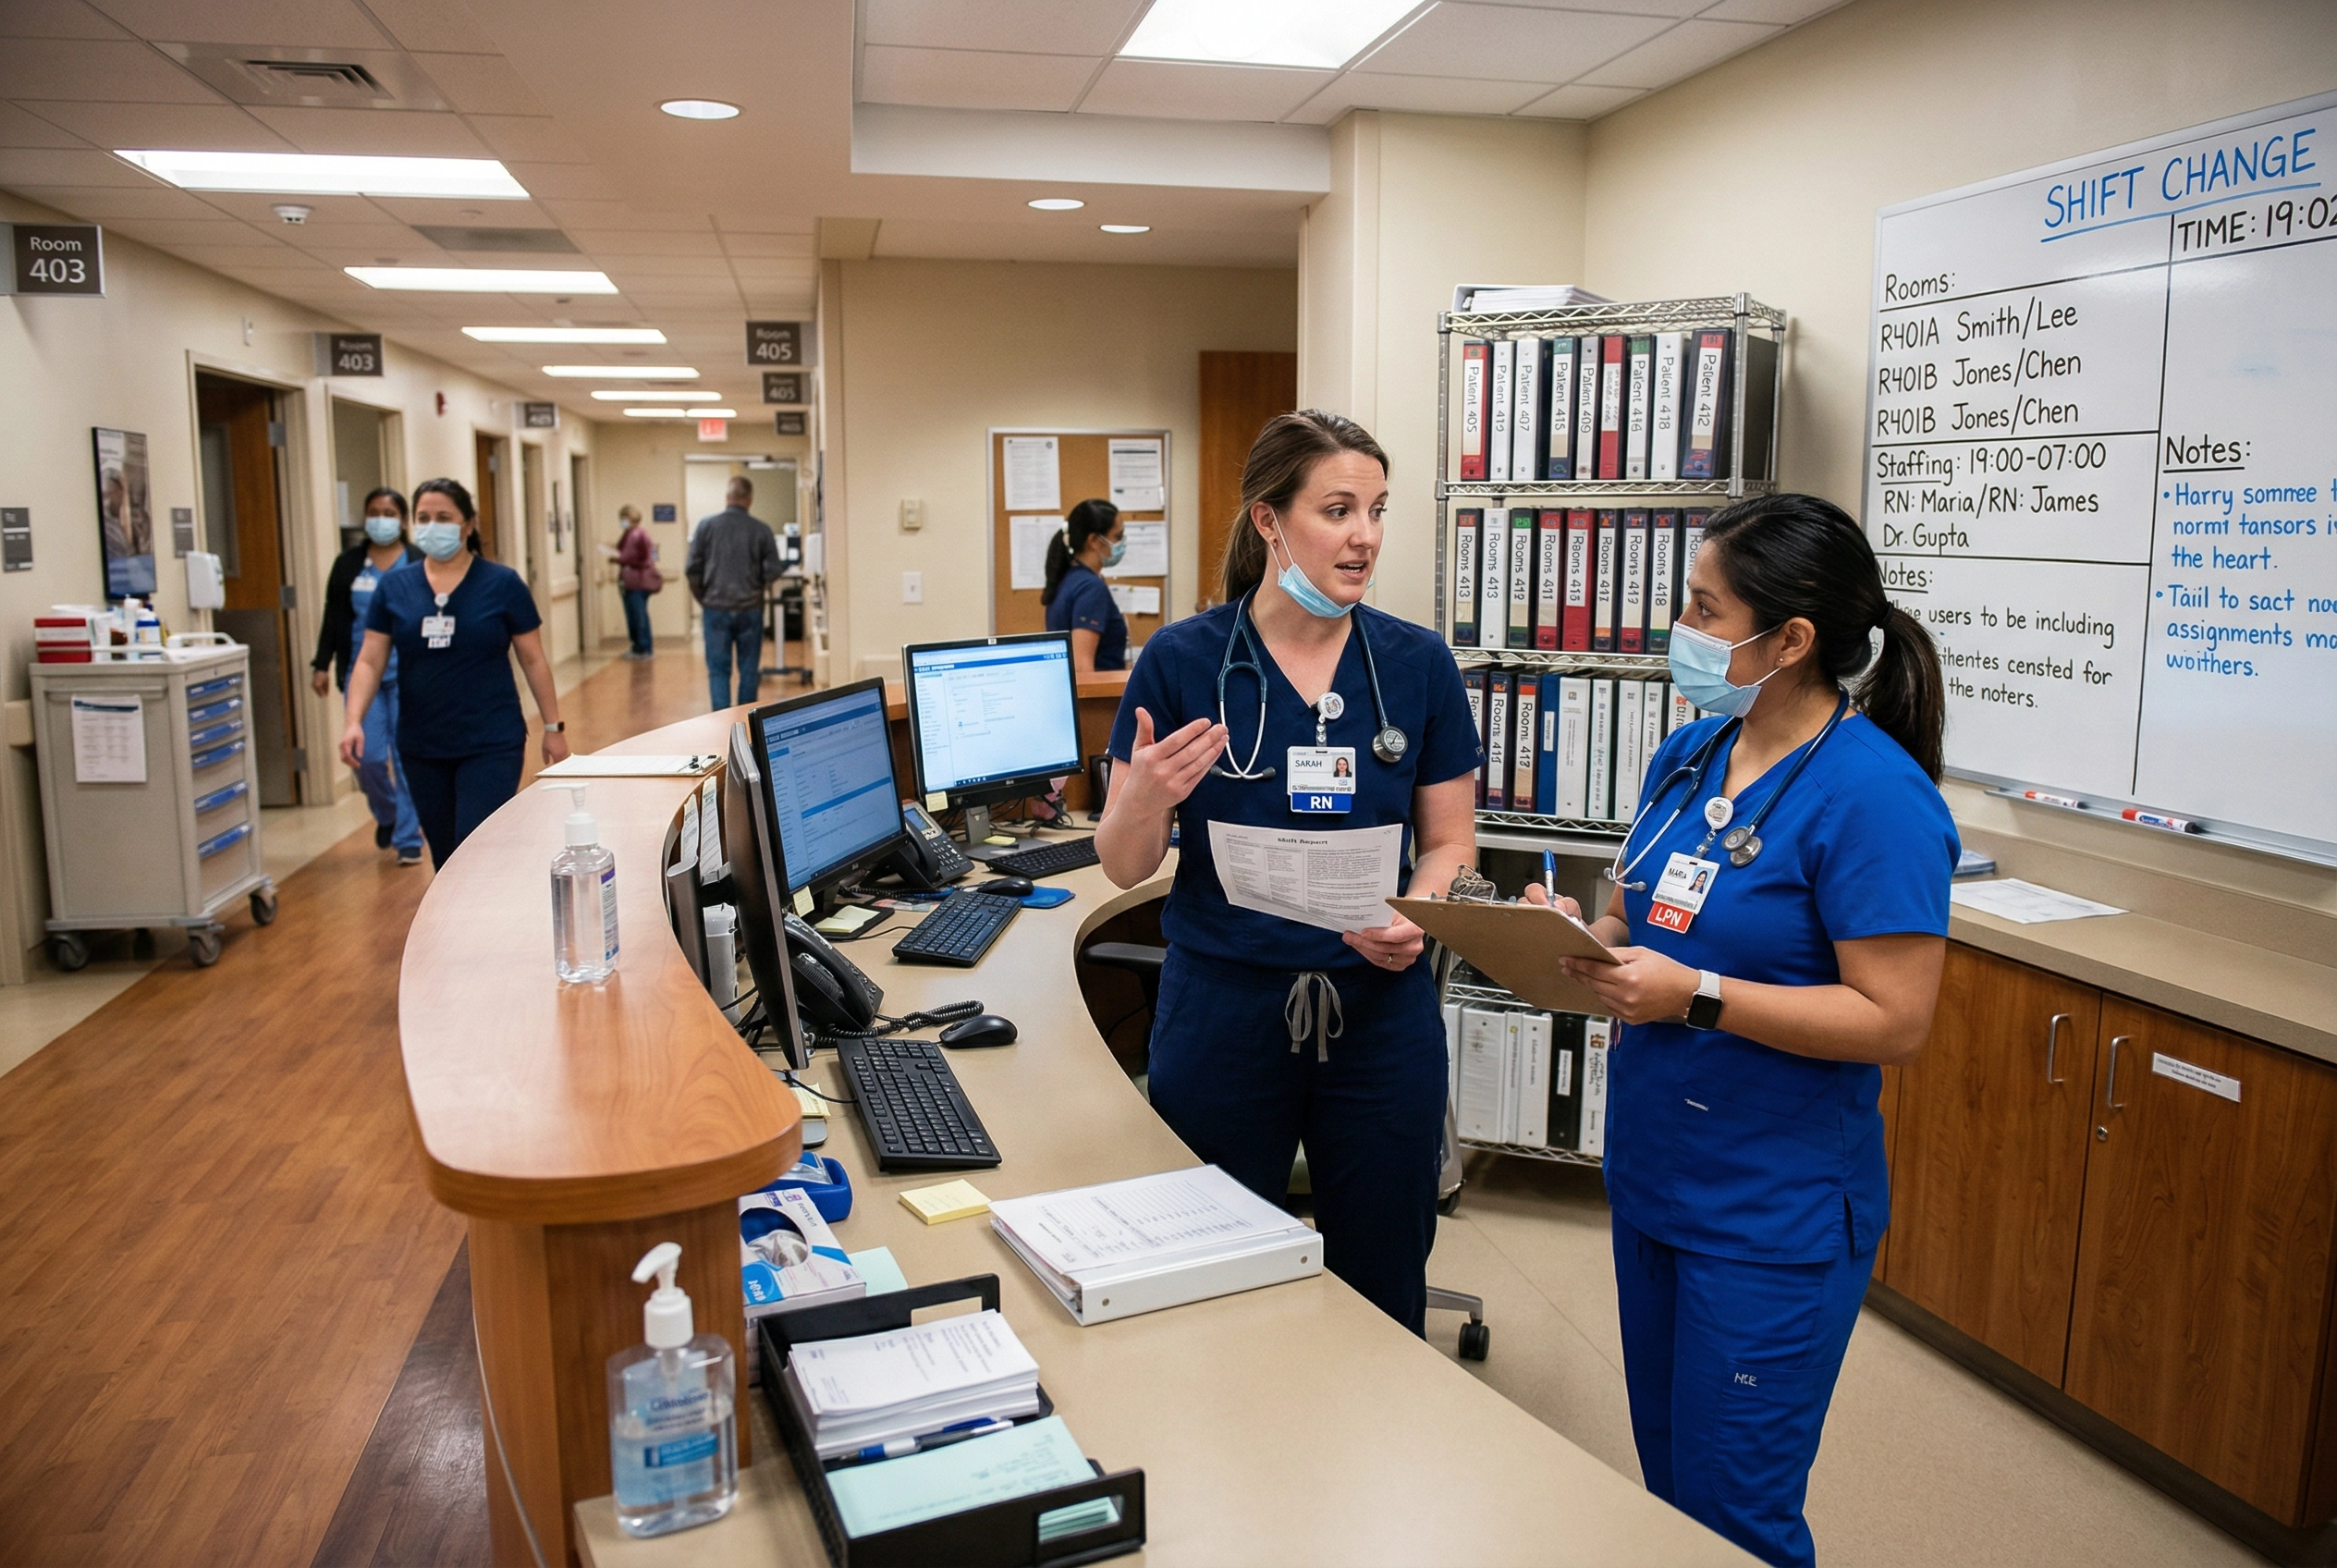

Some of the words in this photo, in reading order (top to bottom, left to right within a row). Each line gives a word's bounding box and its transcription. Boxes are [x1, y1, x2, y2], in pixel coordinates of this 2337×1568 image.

[2044, 166, 2145, 227] SHIFT
[2161, 128, 2316, 202] CHANGE
[30, 236, 82, 251] Room
[2177, 211, 2256, 251] TIME:
[29, 258, 86, 284] 403
[1885, 272, 1956, 303] Rooms:
[1881, 317, 1939, 352] R401A
[1957, 296, 2079, 341] Smith/Lee
[338, 353, 374, 371] 403
[755, 342, 792, 361] 405
[1878, 363, 1938, 396] R401B
[1952, 348, 2081, 387] Jones/Chen
[1519, 410, 1530, 432] 407
[1659, 405, 1671, 430] 418
[1697, 403, 1710, 426] 412
[1878, 406, 1936, 437] R401B
[1952, 394, 2079, 435] Jones/Chen
[1877, 450, 1960, 486] Staffing:
[1970, 442, 2106, 475] 19:00-07:00
[2166, 434, 2250, 465] Notes:
[1884, 489, 1915, 514] RN:
[1921, 484, 2024, 519] Maria/RN:
[2031, 485, 2099, 513] James
[2176, 482, 2233, 515] Harry
[1884, 523, 1907, 547] Dr.
[1913, 522, 1969, 555] Gupta
[2239, 513, 2317, 535] tansors
[1461, 535, 1473, 570] Rooms
[1515, 535, 1527, 573] Rooms
[1657, 535, 1670, 576] Rooms
[2172, 545, 2204, 568] the
[2213, 545, 2278, 570] heart.
[1459, 576, 1470, 597] 413
[1487, 577, 1499, 598] 413
[1655, 582, 1668, 606] 418
[2219, 586, 2239, 608] to
[2249, 588, 2295, 611] sact
[1928, 609, 1972, 626] users
[1980, 606, 1998, 627] to
[2006, 607, 2026, 629] be
[2036, 610, 2114, 650] including
[2167, 619, 2293, 651] assignments
[2008, 656, 2073, 680] censted
[2083, 660, 2112, 685] for
[1949, 677, 1974, 698] the
[1981, 683, 2037, 708] noters.
[1311, 796, 1332, 809] RN
[1655, 906, 1682, 926] LPN
